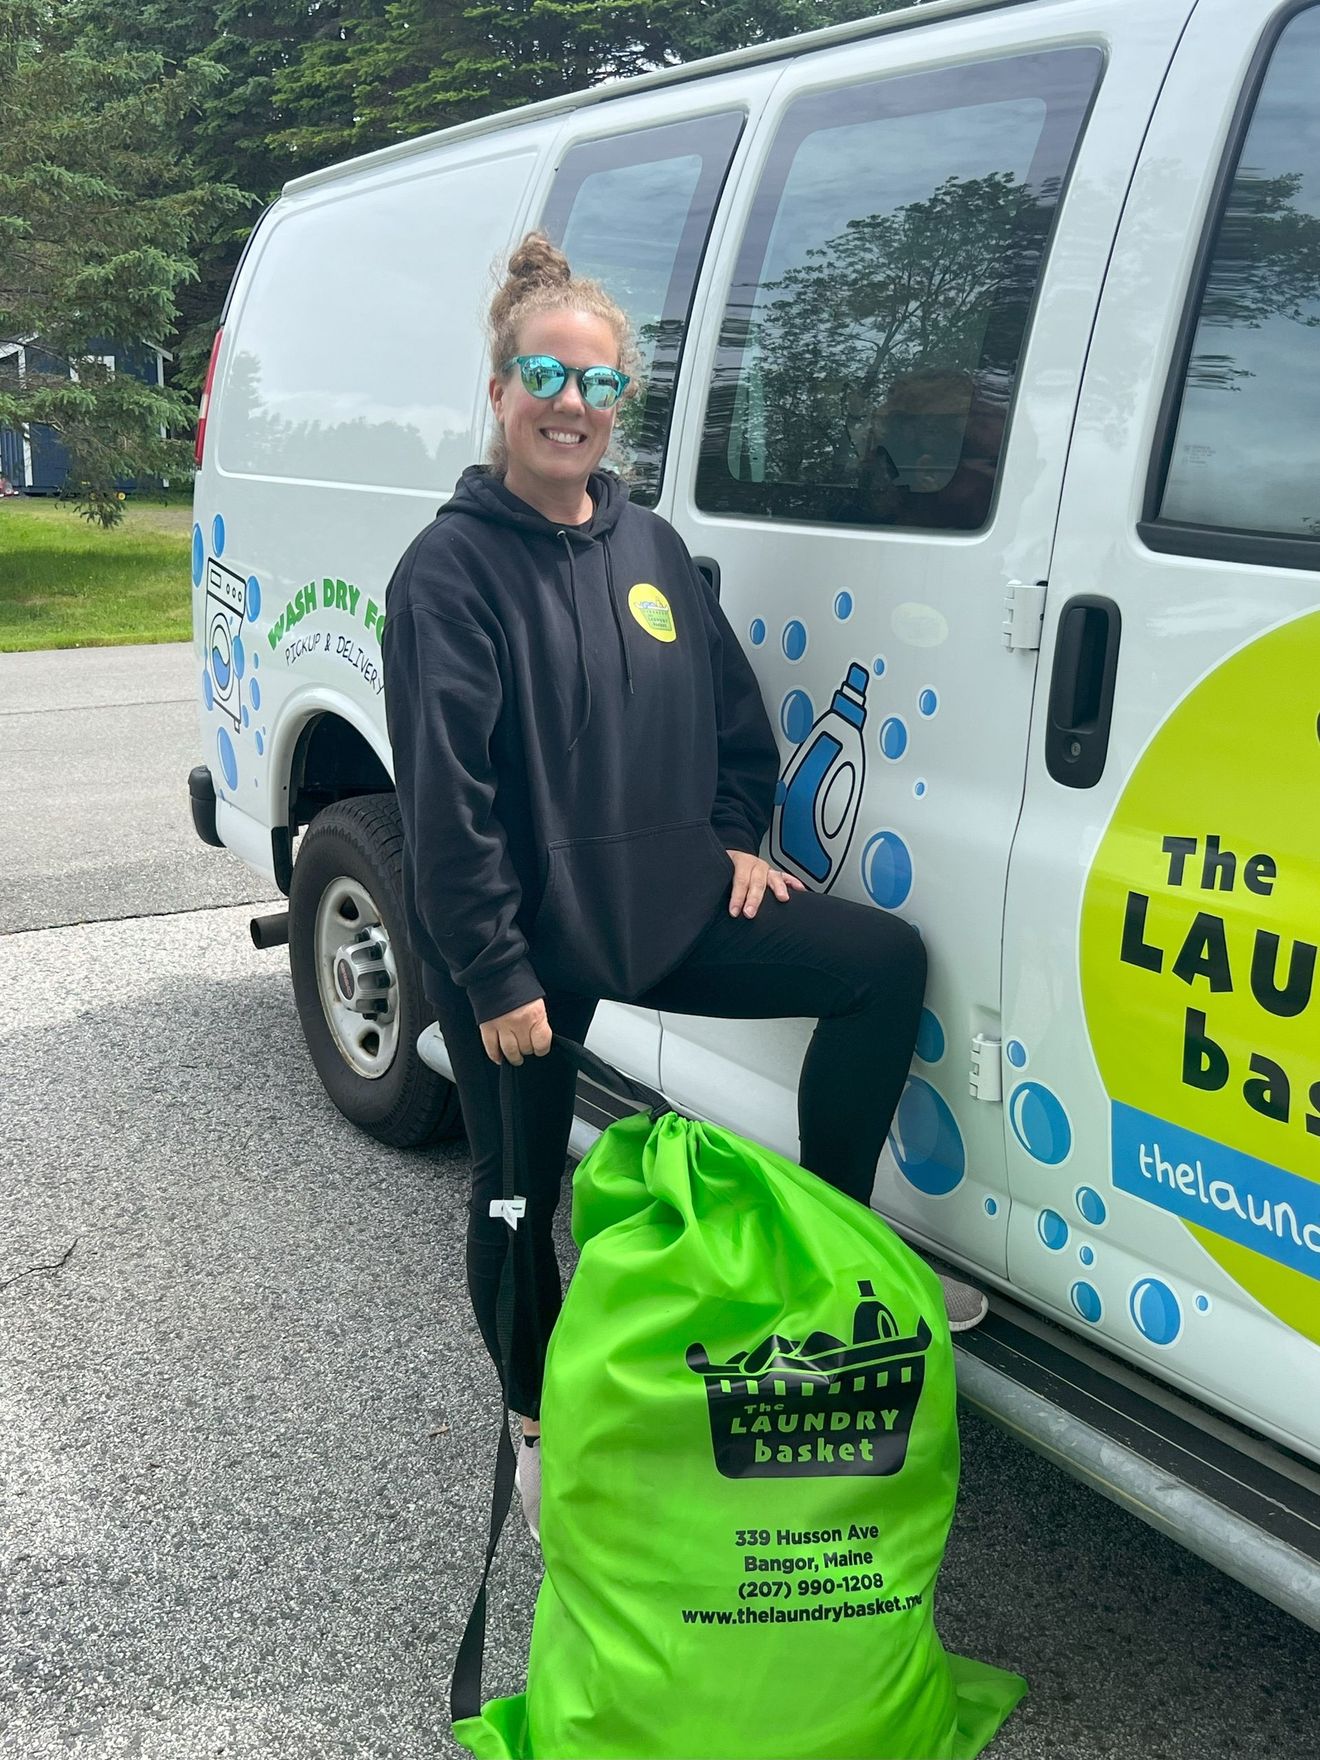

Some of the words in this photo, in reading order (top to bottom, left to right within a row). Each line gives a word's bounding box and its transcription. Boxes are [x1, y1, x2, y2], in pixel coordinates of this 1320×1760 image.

[268, 581, 317, 650] WASH
[323, 578, 361, 616] DRY
[285, 633, 321, 666] PICKUP
[324, 633, 331, 651] &
[336, 636, 384, 695] DELIVERY
[1162, 835, 1276, 896] The
[744, 1403, 784, 1414] The
[730, 1409, 899, 1434] LAUNDRY
[755, 1438, 874, 1463] basket
[735, 1530, 771, 1546] 339
[777, 1529, 842, 1545] Husson
[847, 1524, 879, 1541] Ave
[744, 1556, 819, 1574] Bangor,
[823, 1550, 873, 1568] Maine
[738, 1581, 792, 1600] (207)
[797, 1573, 884, 1596] 990-1208
